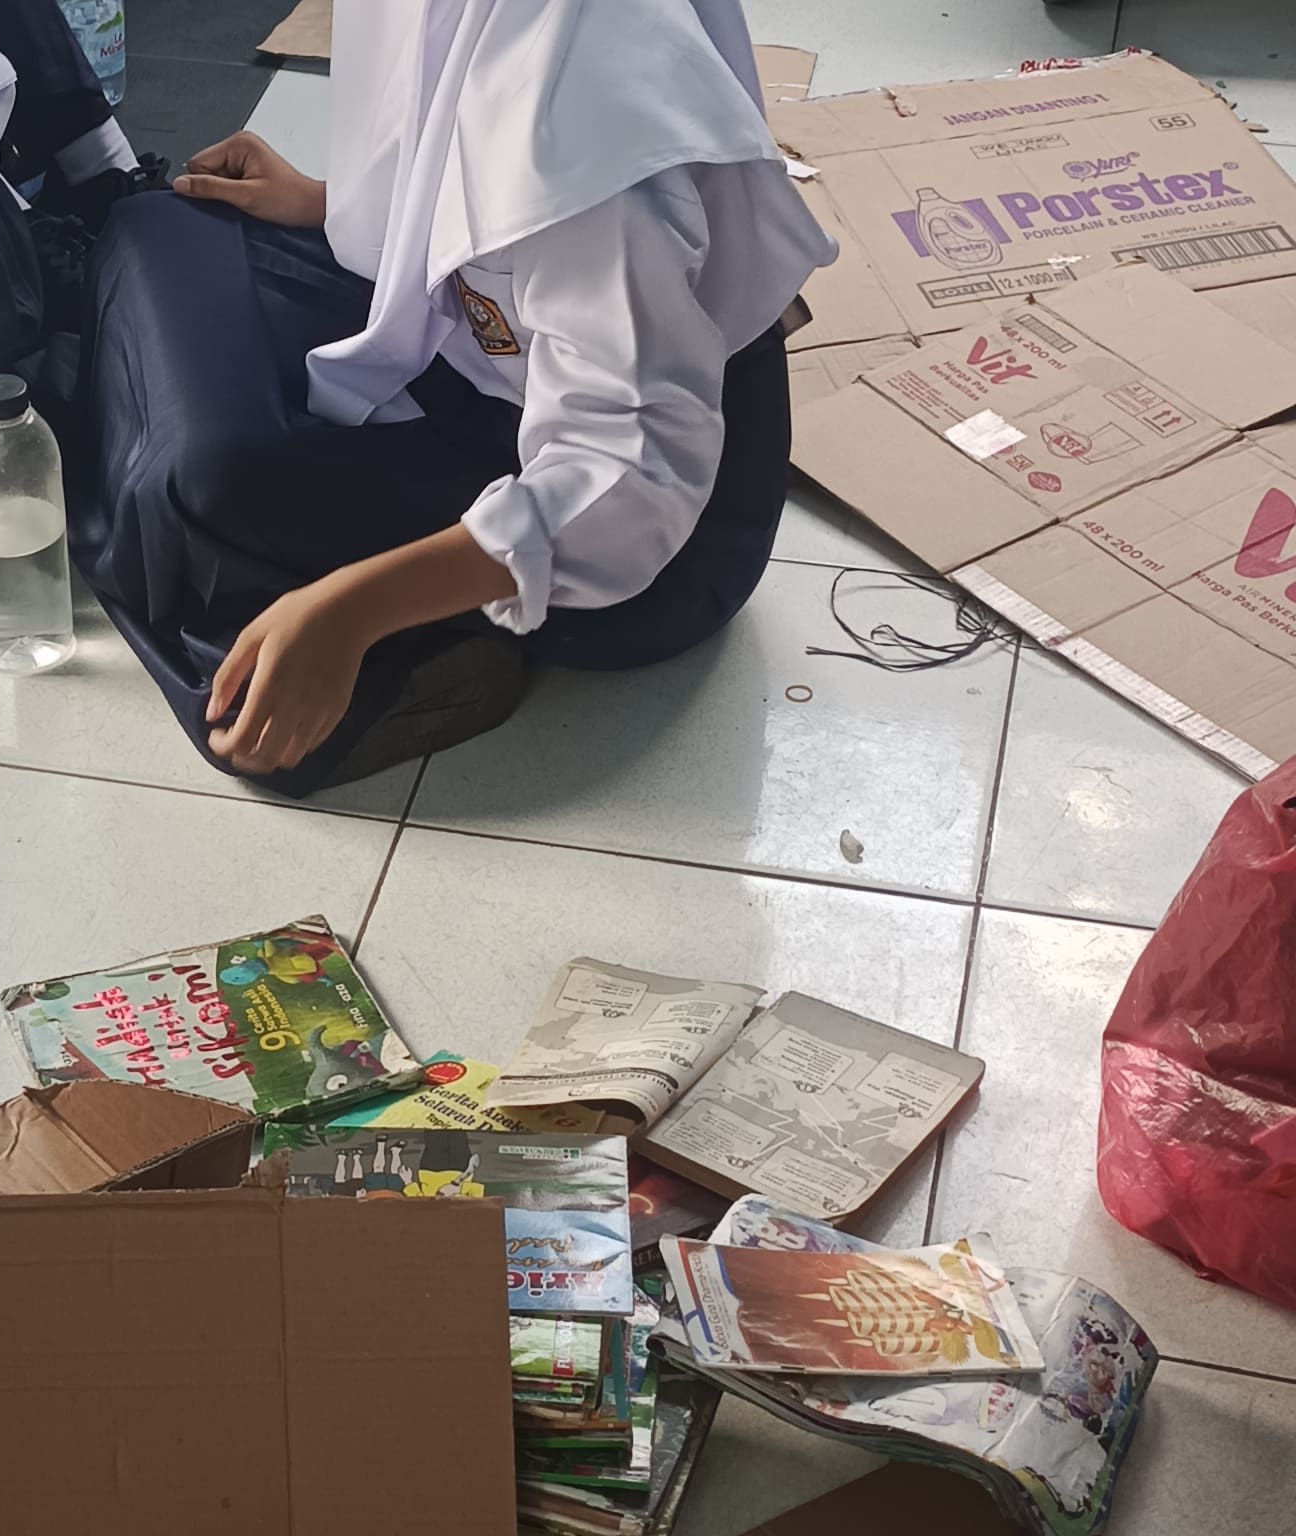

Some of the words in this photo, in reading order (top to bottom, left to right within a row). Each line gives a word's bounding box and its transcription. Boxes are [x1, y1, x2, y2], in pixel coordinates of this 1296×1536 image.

[943, 106, 1009, 127] JANGAN
[1157, 116, 1188, 130] 55
[997, 169, 1244, 230] Porstex
[1023, 219, 1106, 241] PORCELAIN
[1108, 217, 1118, 227] &
[1121, 206, 1186, 225] CERAMIC
[1188, 196, 1256, 214] CLEANER
[998, 277, 1012, 290] 12
[1024, 271, 1053, 286] 1000
[966, 335, 1039, 385] Vit
[1001, 325, 1018, 339] 48
[1025, 341, 1050, 360] 200
[929, 365, 981, 402] Berkualitas
[943, 360, 973, 385] Harga
[1083, 520, 1104, 535] 48
[1111, 539, 1143, 560] 200
[1142, 557, 1166, 573] ml
[1192, 570, 1232, 597] Harga
[1232, 594, 1257, 613] Pas
[245, 1008, 263, 1034] Cerita
[259, 1030, 303, 1052] 9
